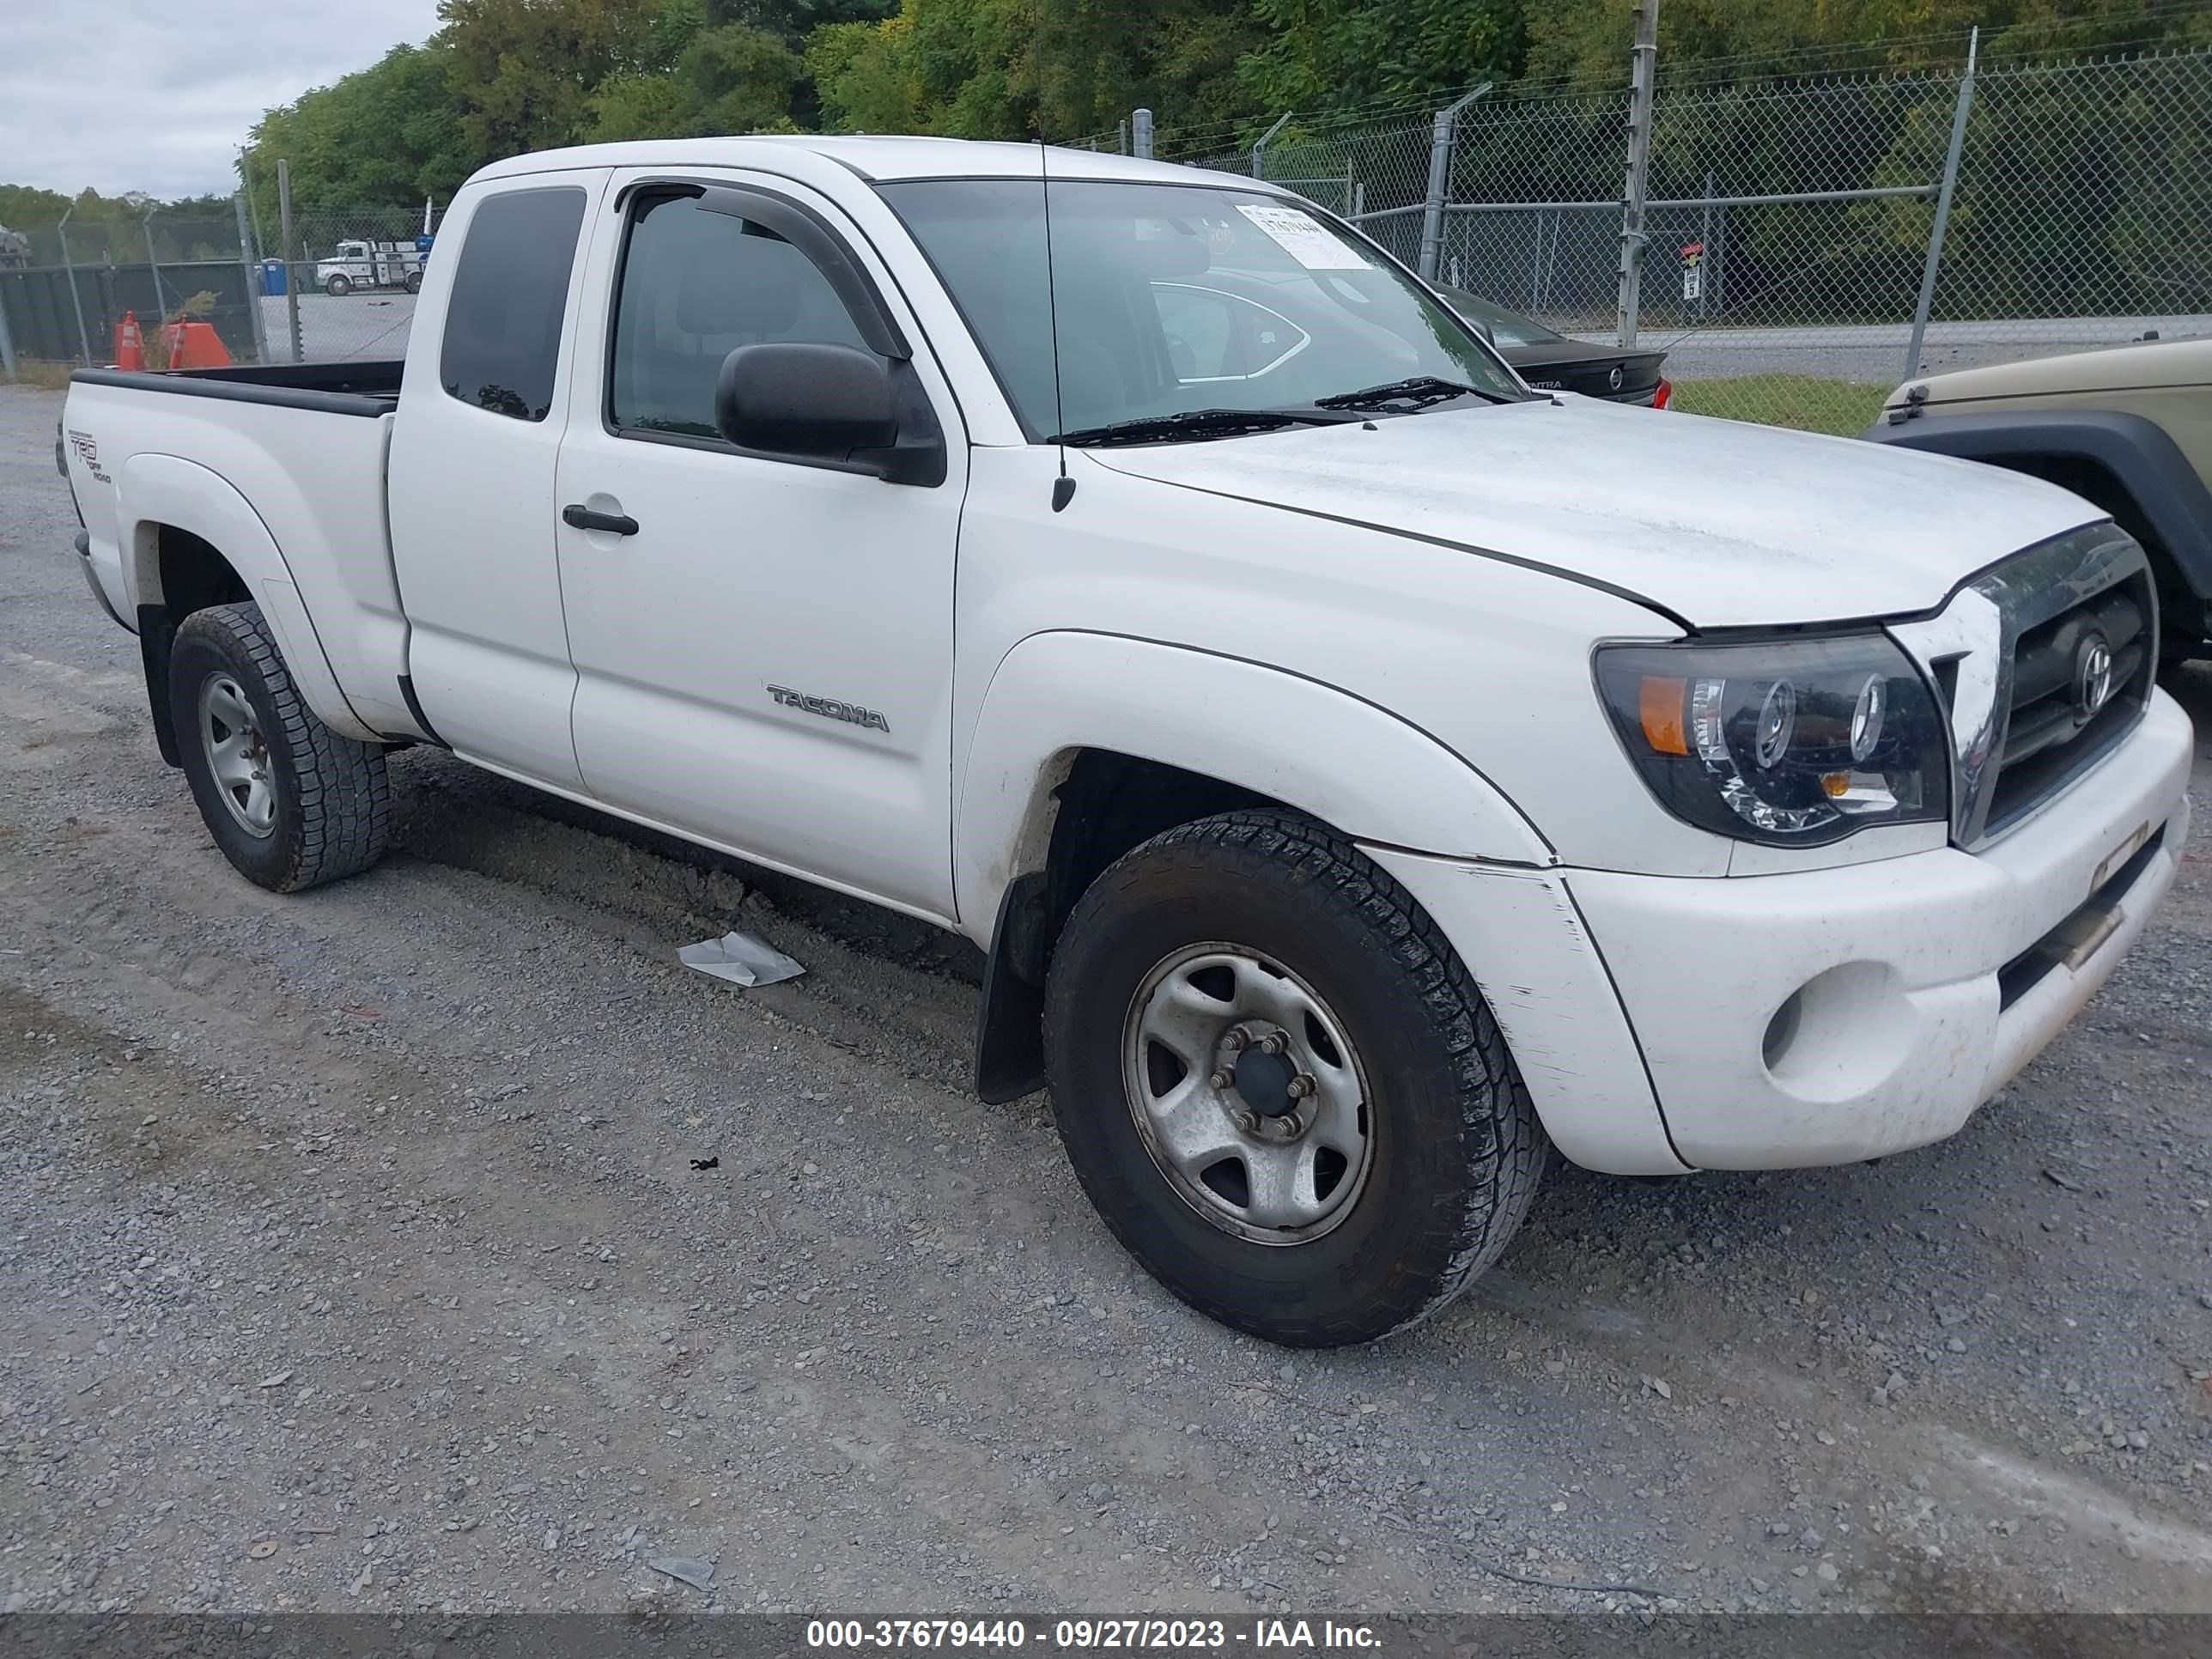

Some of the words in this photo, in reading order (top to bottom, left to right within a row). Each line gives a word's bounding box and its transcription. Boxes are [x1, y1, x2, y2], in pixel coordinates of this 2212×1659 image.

[1689, 283, 1695, 296] 5
[70, 435, 97, 464] TRD
[88, 462, 102, 471] OFF
[94, 471, 111, 483] ROAD
[765, 684, 890, 733] TACOMA
